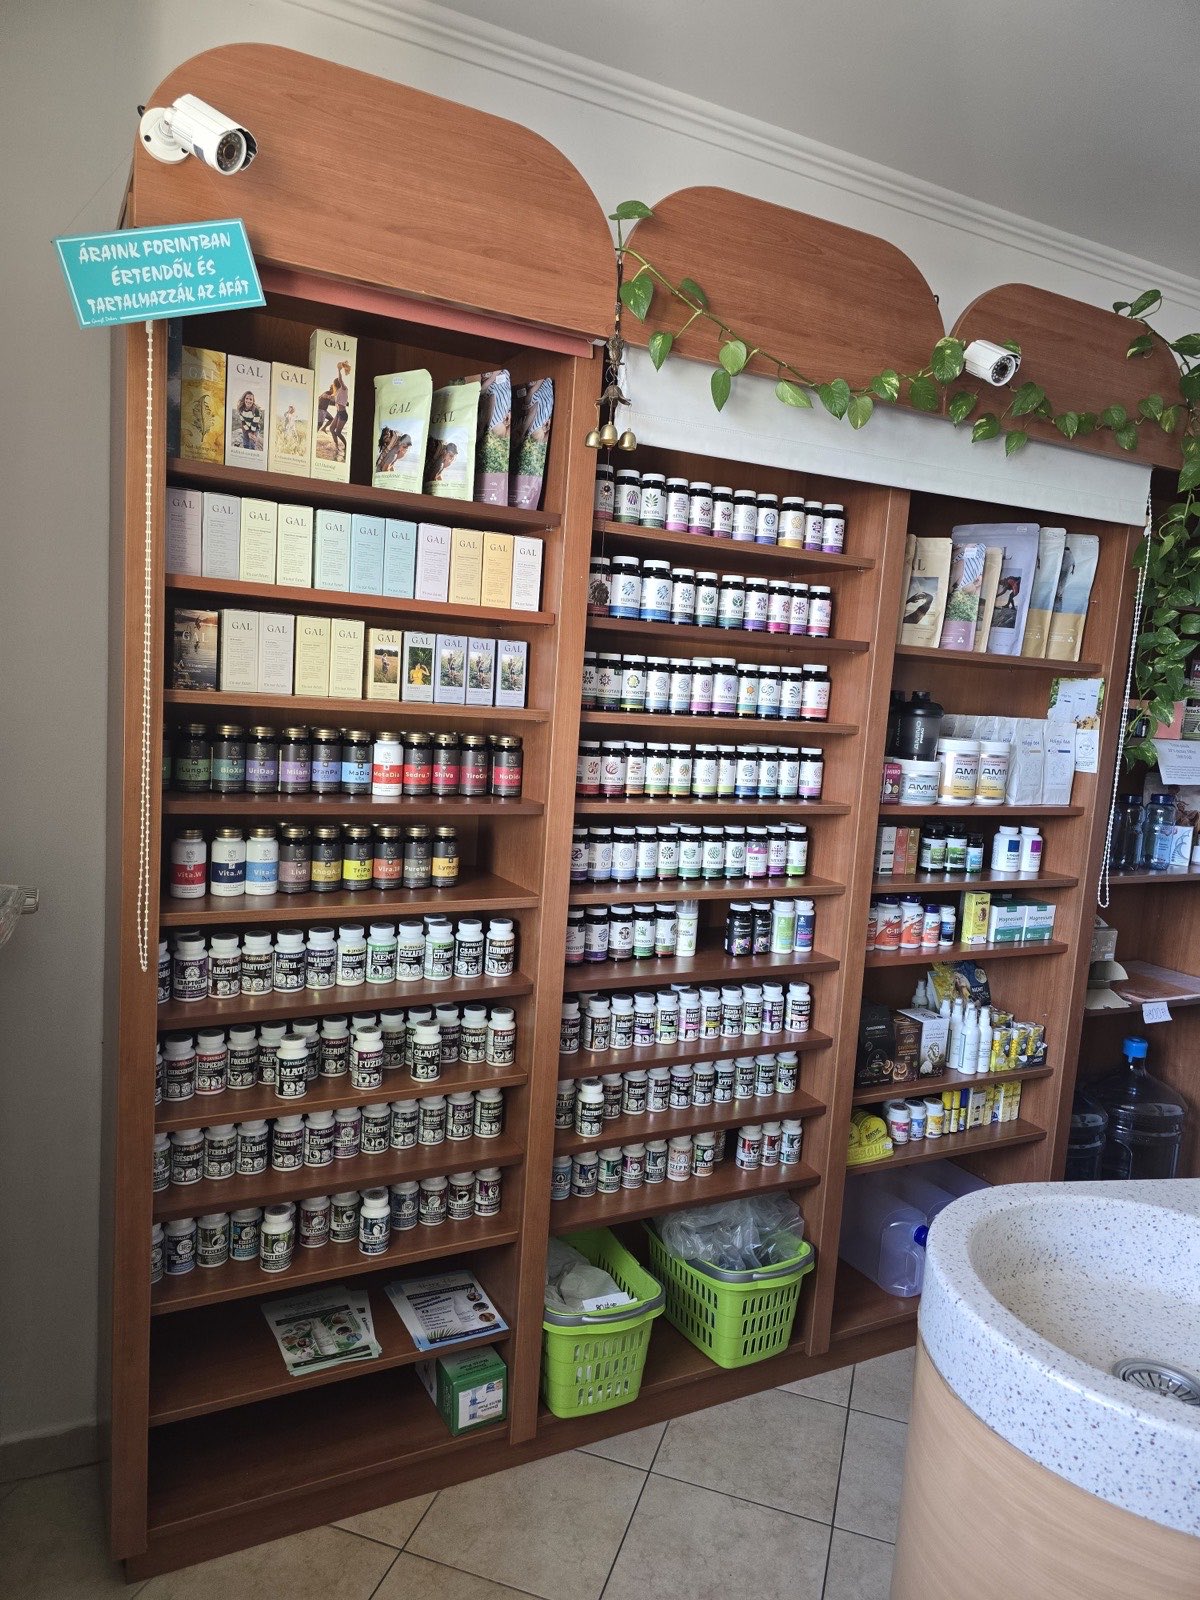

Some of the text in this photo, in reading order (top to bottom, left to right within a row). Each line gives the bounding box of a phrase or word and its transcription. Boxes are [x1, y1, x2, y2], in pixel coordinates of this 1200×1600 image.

[79, 232, 230, 264] ÁRAINK FORINTBAN
[111, 255, 215, 286] ÉRTENDŐK ÉS
[87, 275, 249, 314] TARTALMAZZÁK AZ ÁFÁT
[325, 337, 350, 352] GAL
[236, 363, 263, 378] GAL
[281, 370, 307, 385] GAL
[389, 402, 412, 415] GAL
[432, 411, 456, 424] GAL
[172, 499, 195, 509] GAL
[212, 504, 233, 515] GAL
[249, 511, 270, 522] GAL
[286, 517, 307, 527] GAL
[325, 522, 345, 532] GAL
[359, 527, 378, 536] GAL
[391, 531, 410, 541] GAL
[427, 535, 445, 545] GAL
[459, 540, 478, 549] GAL
[490, 543, 508, 553] GAL
[519, 548, 537, 557] GAL
[232, 622, 253, 631] GAL
[267, 624, 288, 634] GAL
[182, 631, 209, 643] GAL
[304, 627, 324, 637] GAL
[339, 630, 358, 639] GAL
[377, 634, 397, 643] GAL
[411, 636, 431, 646] GAL
[444, 639, 462, 648] GAL
[472, 641, 491, 651] GAL
[504, 644, 523, 653] GAL
